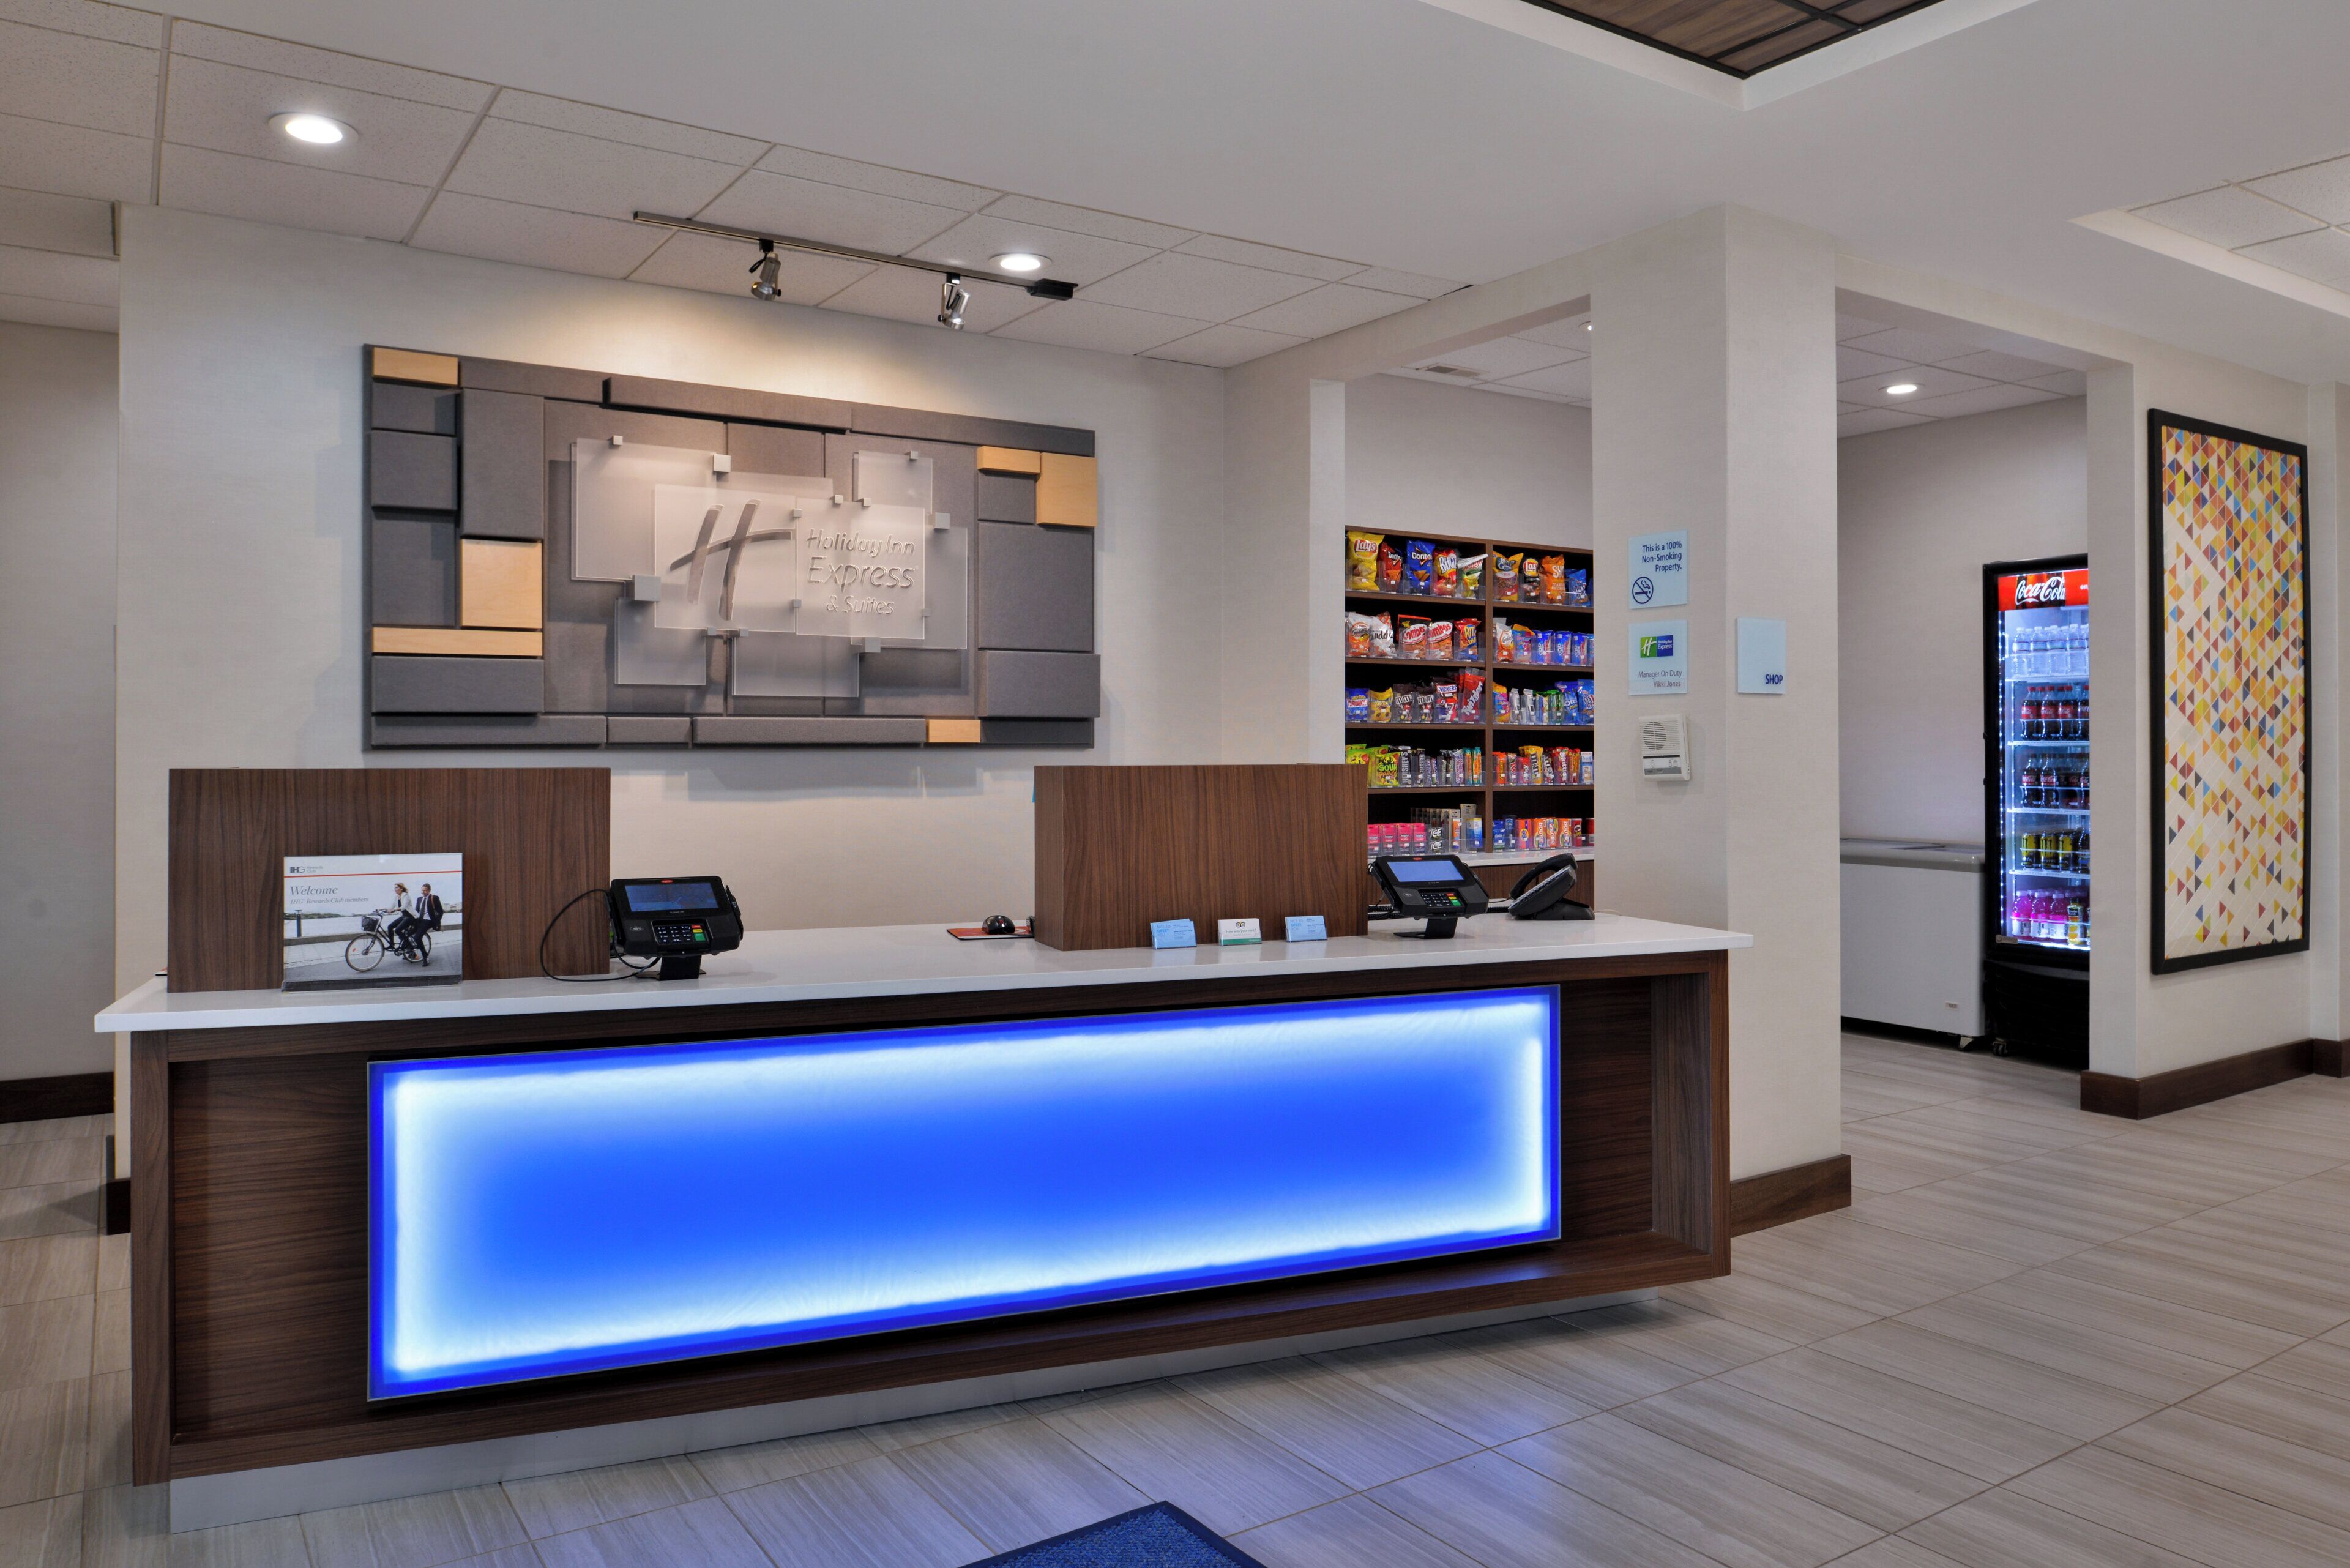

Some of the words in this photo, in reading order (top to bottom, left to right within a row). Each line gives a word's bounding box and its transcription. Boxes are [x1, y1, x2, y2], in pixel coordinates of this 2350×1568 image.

[807, 528, 882, 558] Holiday
[886, 534, 915, 554] Inn
[1643, 544, 1654, 553] This
[1666, 540, 1682, 550] 100%
[1642, 552, 1682, 564] Non-Smoking
[1655, 563, 1682, 572] Property.
[807, 556, 916, 593] Express
[2015, 577, 2065, 605] Coca-Cola
[826, 594, 838, 613] &
[843, 595, 895, 614] Suites
[1765, 674, 1783, 684] SHOP
[290, 886, 338, 895] Welcome
